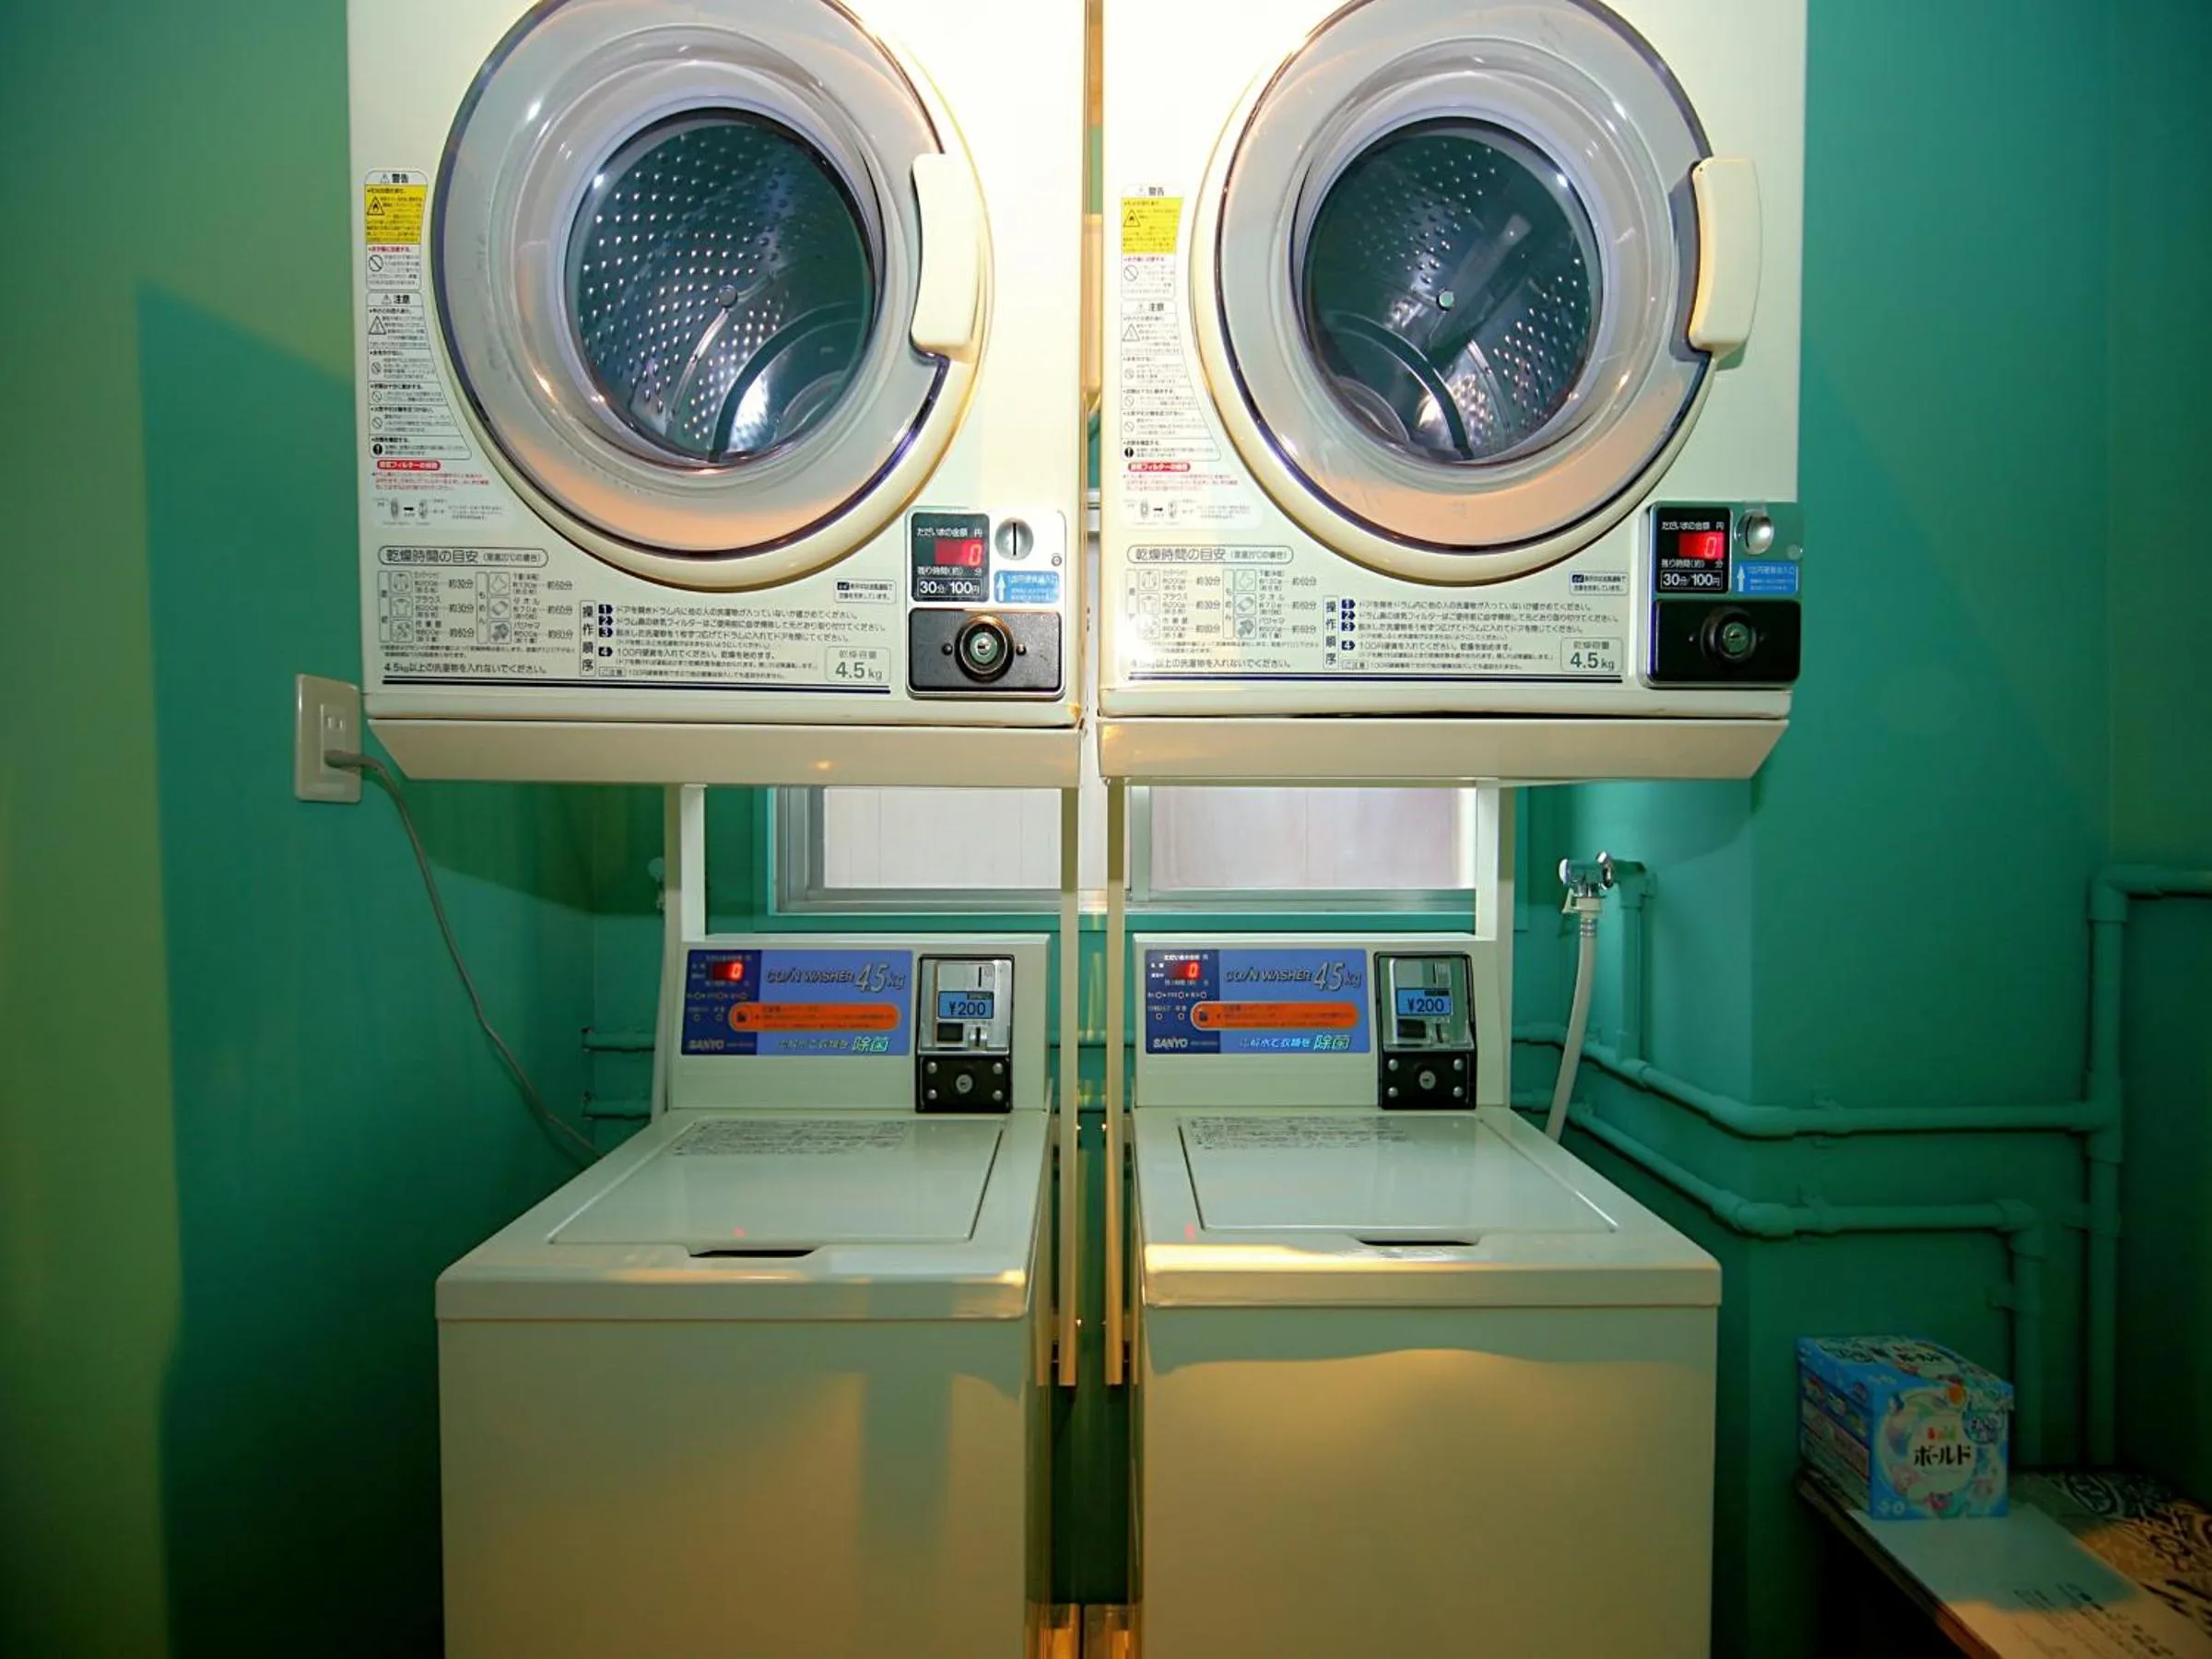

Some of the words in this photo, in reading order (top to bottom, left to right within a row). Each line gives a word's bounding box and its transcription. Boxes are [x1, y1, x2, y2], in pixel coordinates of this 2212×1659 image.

[394, 294, 410, 304] 注意
[1148, 302, 1164, 312] 注意
[1716, 522, 1724, 530] 円
[970, 544, 982, 566] 0
[1135, 547, 1226, 560] 乾燥時間の目安
[1705, 536, 1717, 559] 0
[386, 549, 478, 563] 乾燥時間の目安
[582, 606, 594, 672] 操作順序
[1325, 601, 1336, 665] 操作順序
[731, 962, 743, 979] 0
[802, 970, 855, 983] WASHER
[1187, 961, 1198, 978] 0
[1261, 969, 1312, 982] WASHER
[949, 1001, 986, 1016] ¥200
[1407, 997, 1444, 1012] ¥200
[688, 1039, 724, 1050] SANYO
[853, 1035, 890, 1052] 除菌
[1153, 1037, 1188, 1049] SANYO
[1913, 1444, 1971, 1466] ボールド
